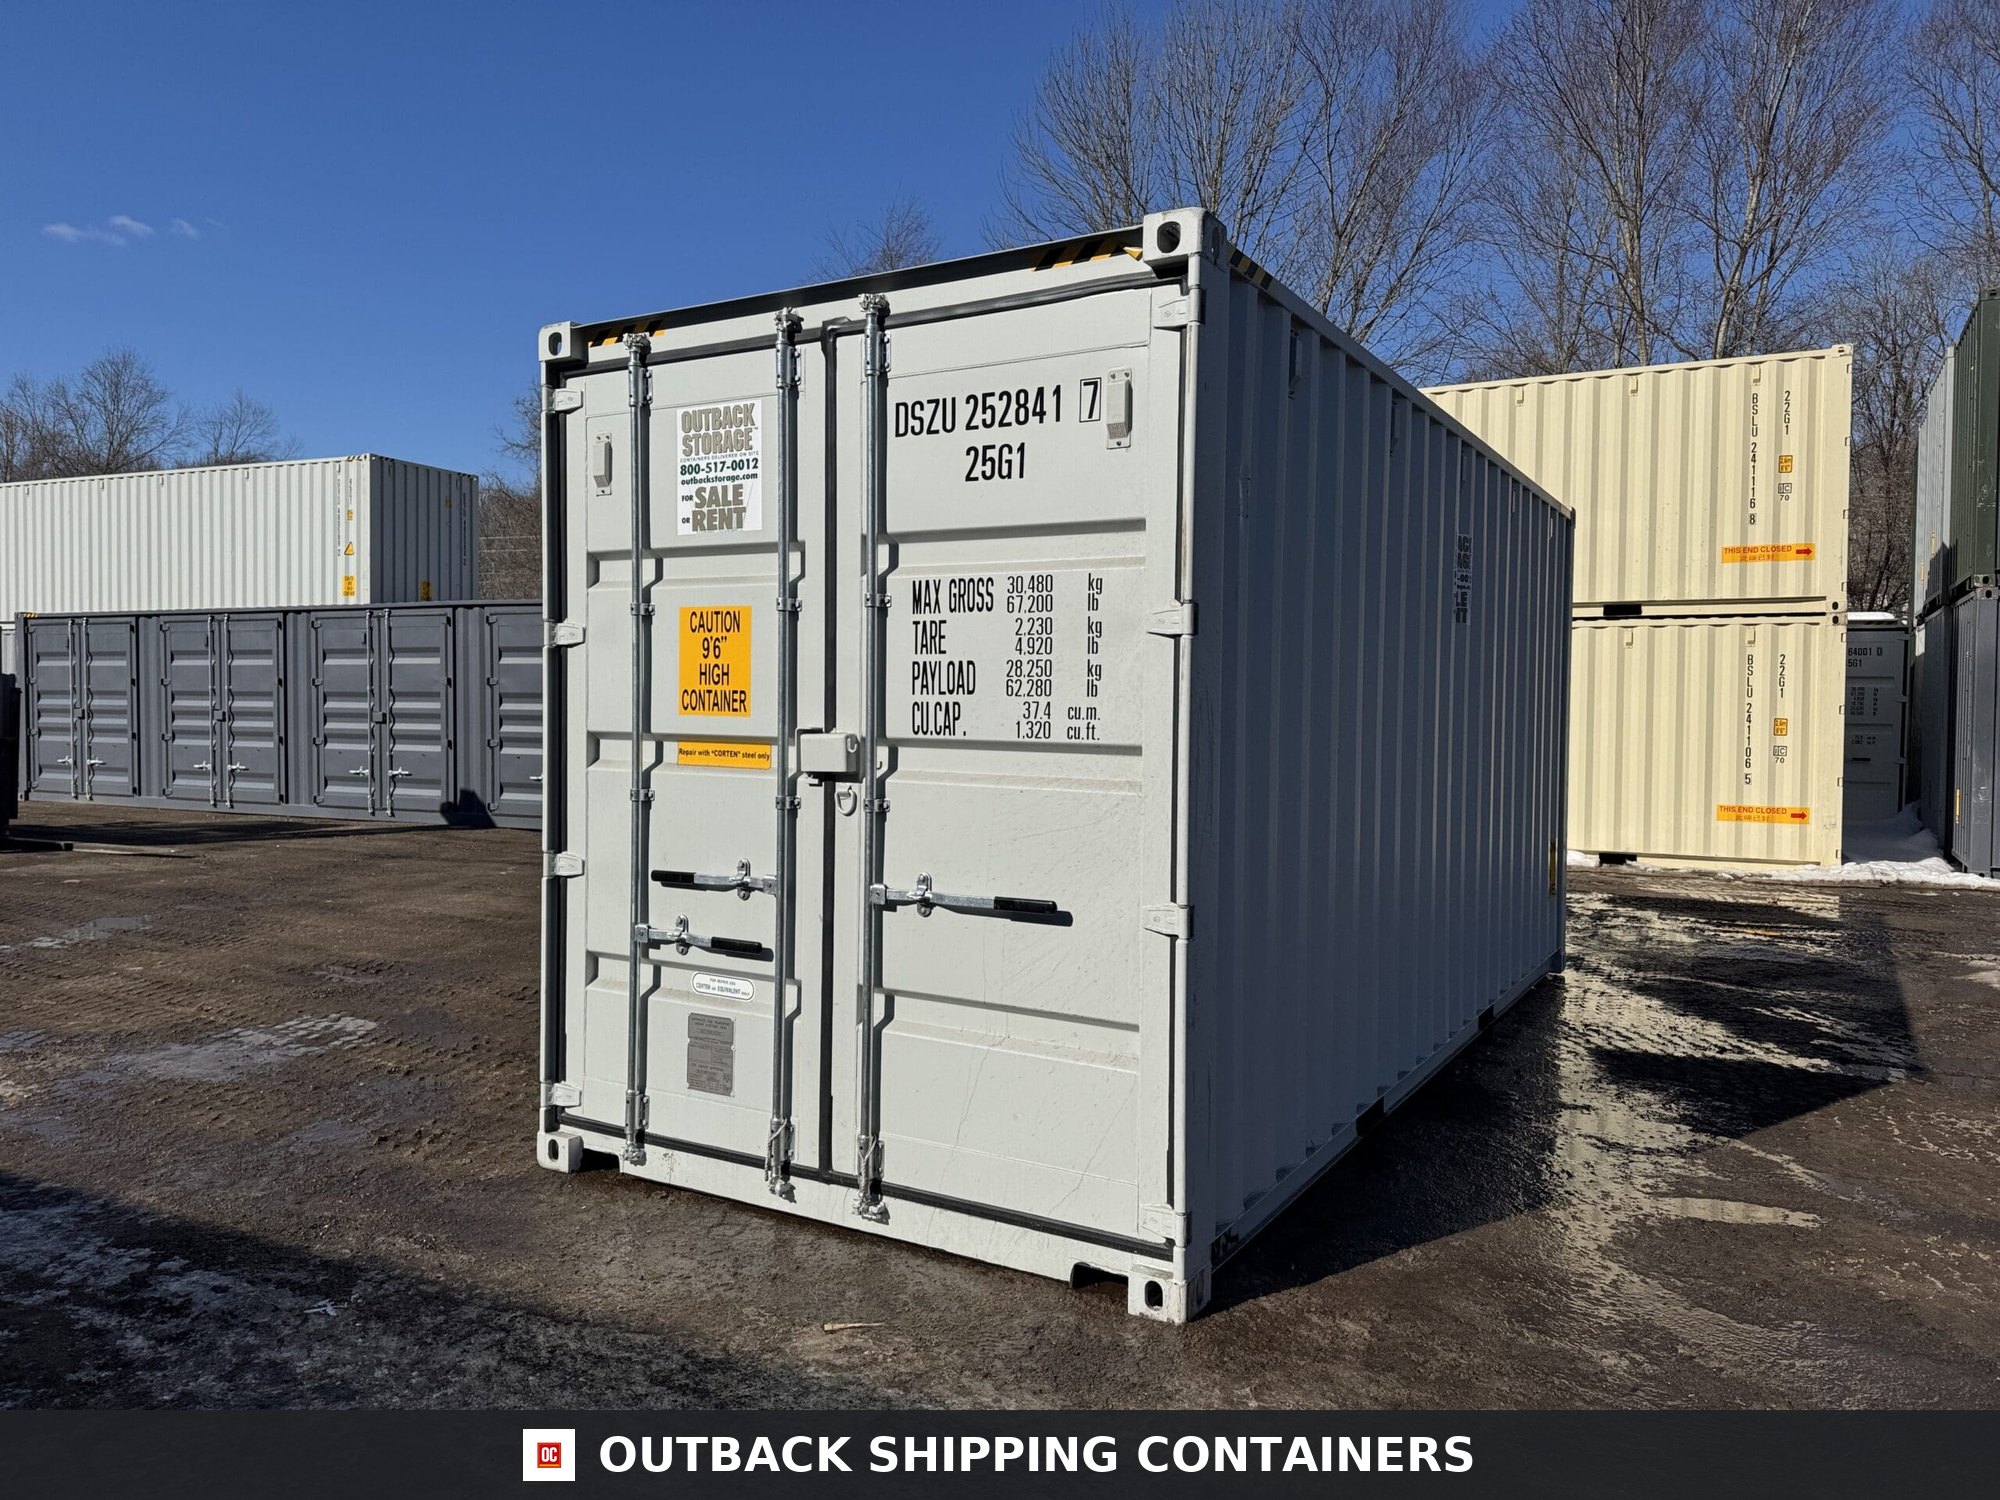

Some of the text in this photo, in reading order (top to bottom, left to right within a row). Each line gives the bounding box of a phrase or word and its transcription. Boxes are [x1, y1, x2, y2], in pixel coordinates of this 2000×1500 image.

[681, 403, 755, 433] OUTBACK
[895, 380, 1099, 438] DSZU 252841 7
[1751, 393, 1759, 438] BSLU
[1783, 390, 1791, 436] 22G1
[680, 458, 758, 476] 800-517-0012
[965, 442, 1025, 482] 25G1
[681, 473, 758, 485] outbackstorage.com
[1749, 442, 1758, 509] 241116
[695, 484, 743, 509] SALE
[692, 507, 746, 531] RENT
[1742, 546, 1758, 554] END
[1760, 545, 1792, 553] CLOSED
[912, 573, 1103, 615] MAX GROSS 30,480 kg
[1007, 593, 1098, 613] 67,200 lb
[690, 611, 740, 633] CAUTION
[912, 616, 1102, 655] TARE 2,230 kg
[1015, 636, 1098, 655] 4,920 lb
[702, 636, 727, 659] 9'6"
[1848, 647, 1872, 656] 64001
[699, 663, 729, 686] HIGH
[1848, 659, 1862, 667] 5G1
[912, 659, 1101, 695] PAYLOAD 28,250 kg
[1006, 679, 1097, 697] 62,280 lb
[682, 689, 747, 713] CONTAINER
[1023, 701, 1051, 720] 37.4
[1067, 705, 1101, 721] cu.m.
[1016, 720, 1100, 740] 1,320 cu.ft.
[1744, 703, 1752, 769] 241106
[679, 748, 770, 761] Repair with "CORTEN" steel only
[1719, 805, 1736, 813] THIS
[1755, 806, 1787, 815] CLOSED
